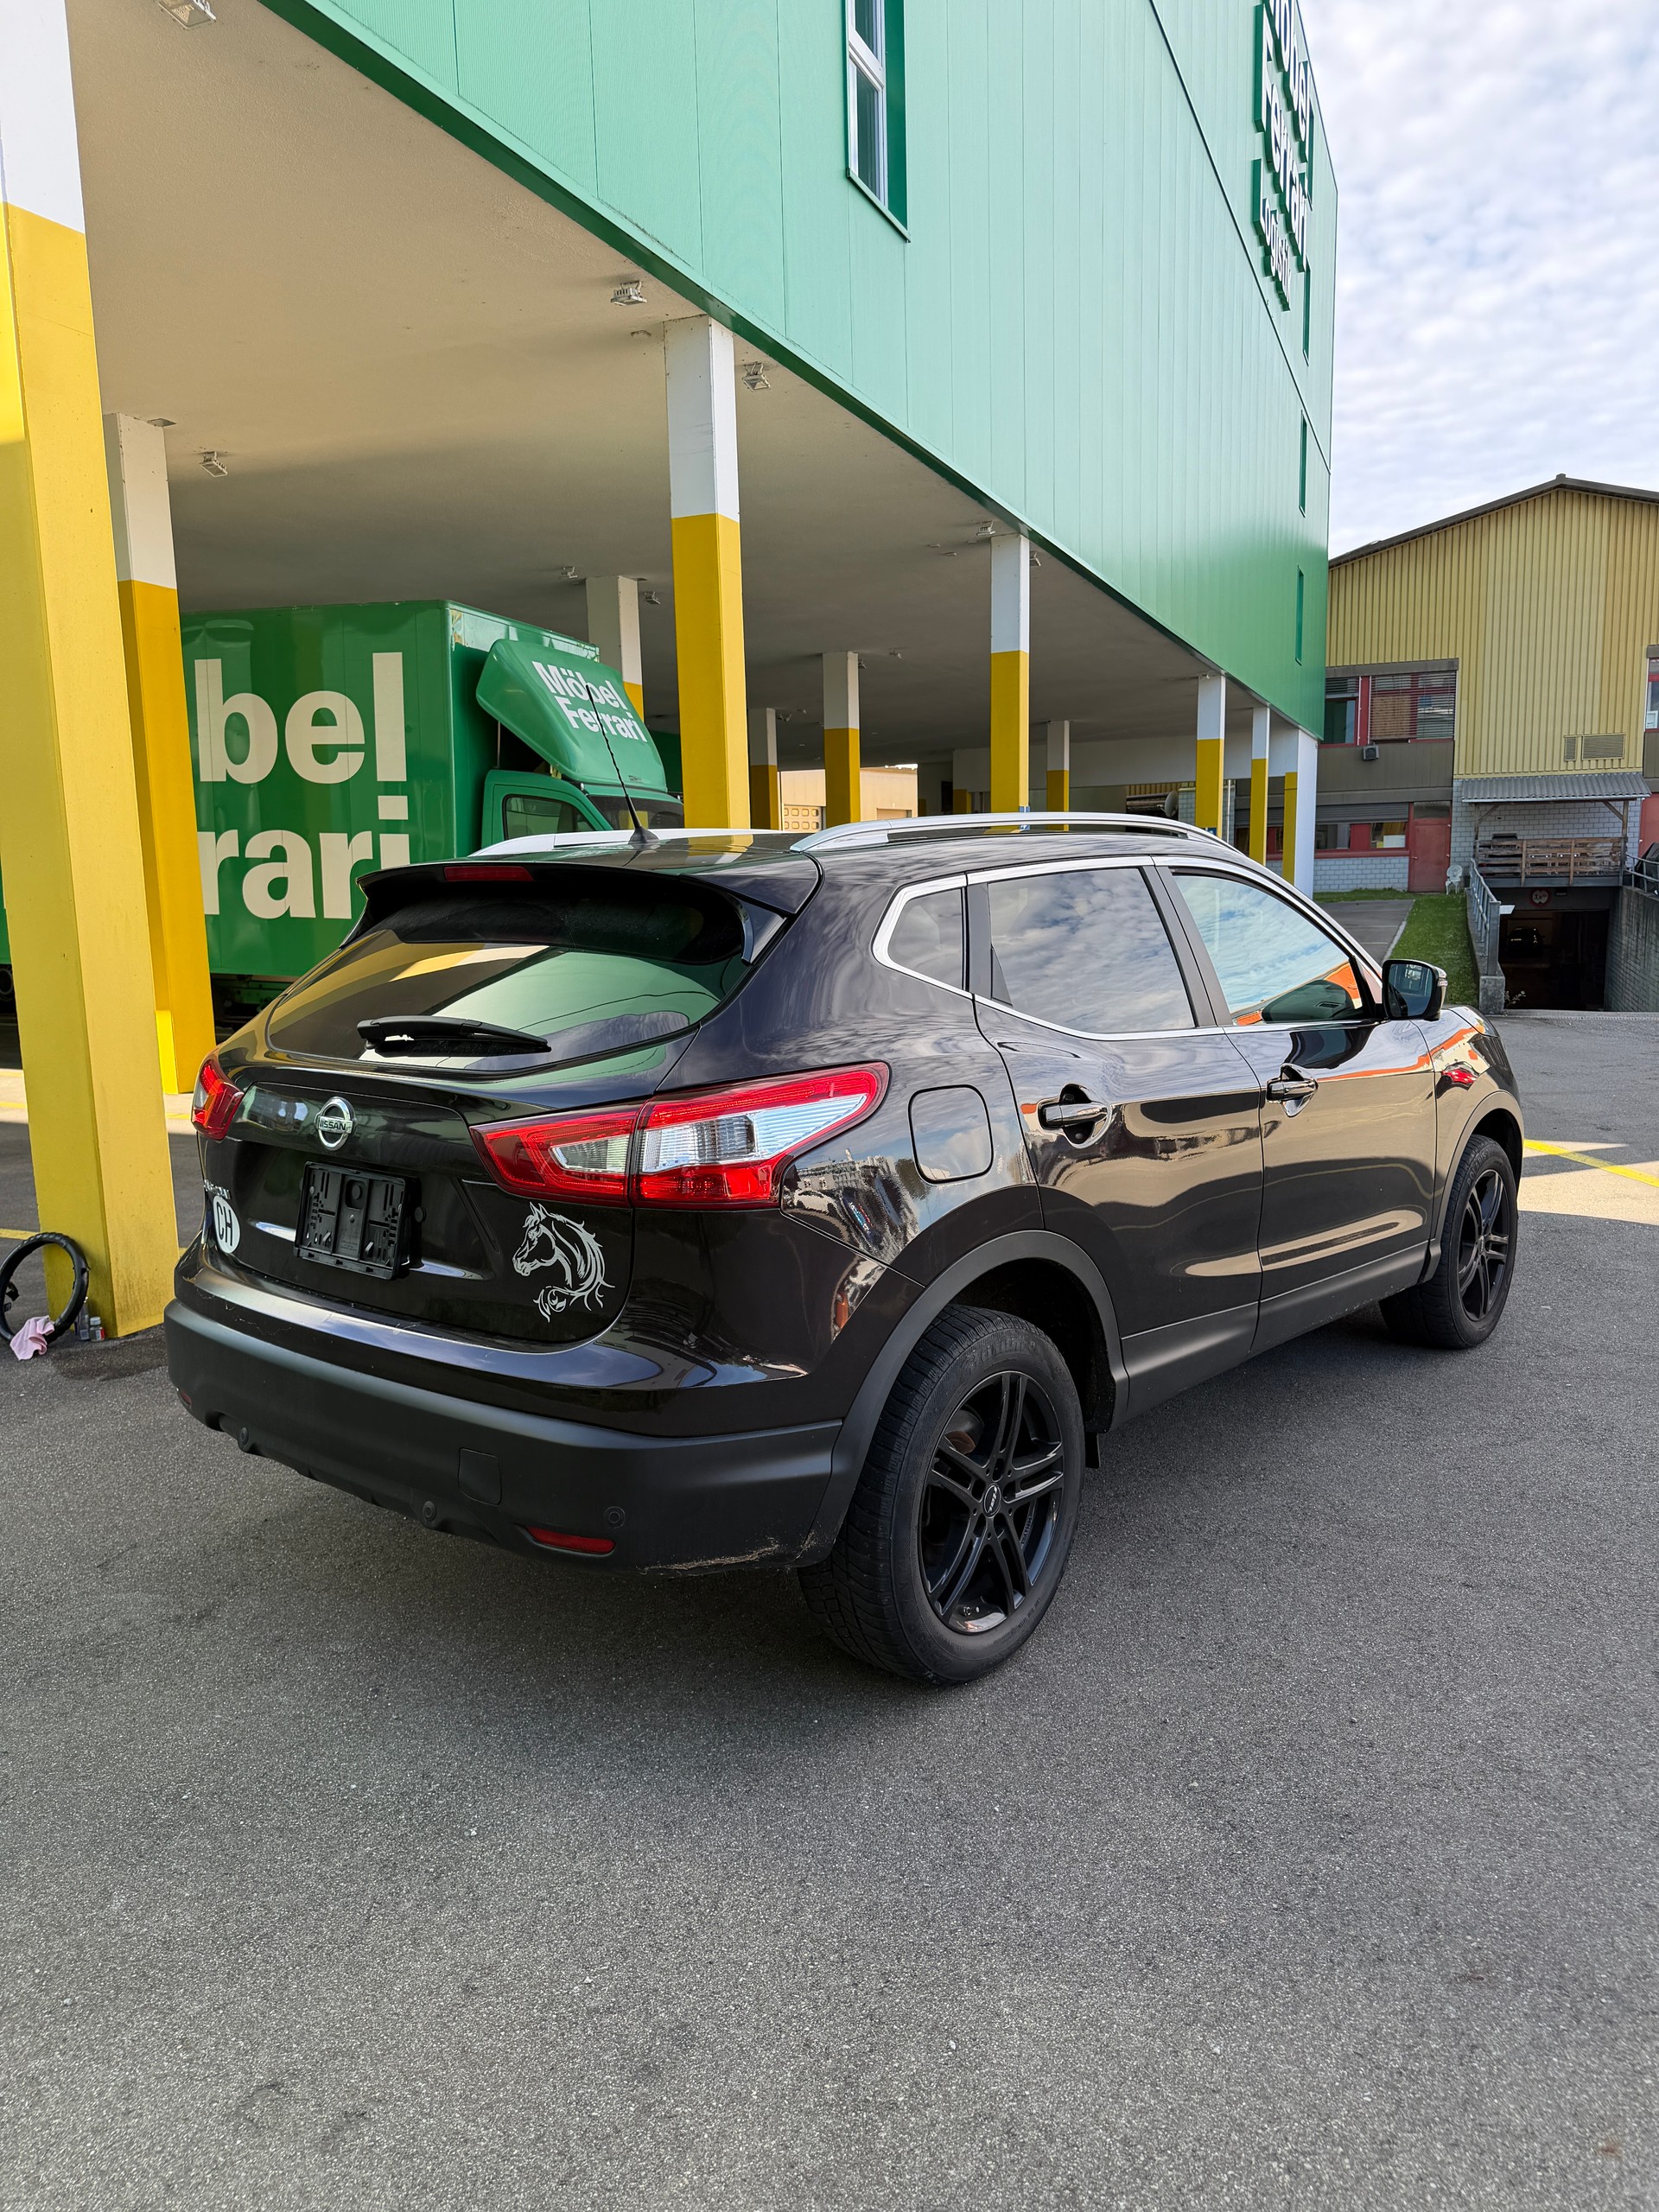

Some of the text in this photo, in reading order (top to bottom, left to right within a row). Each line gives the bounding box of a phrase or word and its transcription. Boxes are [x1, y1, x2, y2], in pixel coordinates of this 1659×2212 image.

[1268, 0, 1310, 162] öbel
[1262, 3, 1307, 272] Ferrari
[531, 660, 628, 710] Möbel
[554, 695, 648, 743] Ferrari
[319, 1119, 346, 1131] NISSAN
[216, 1201, 233, 1247] CH
